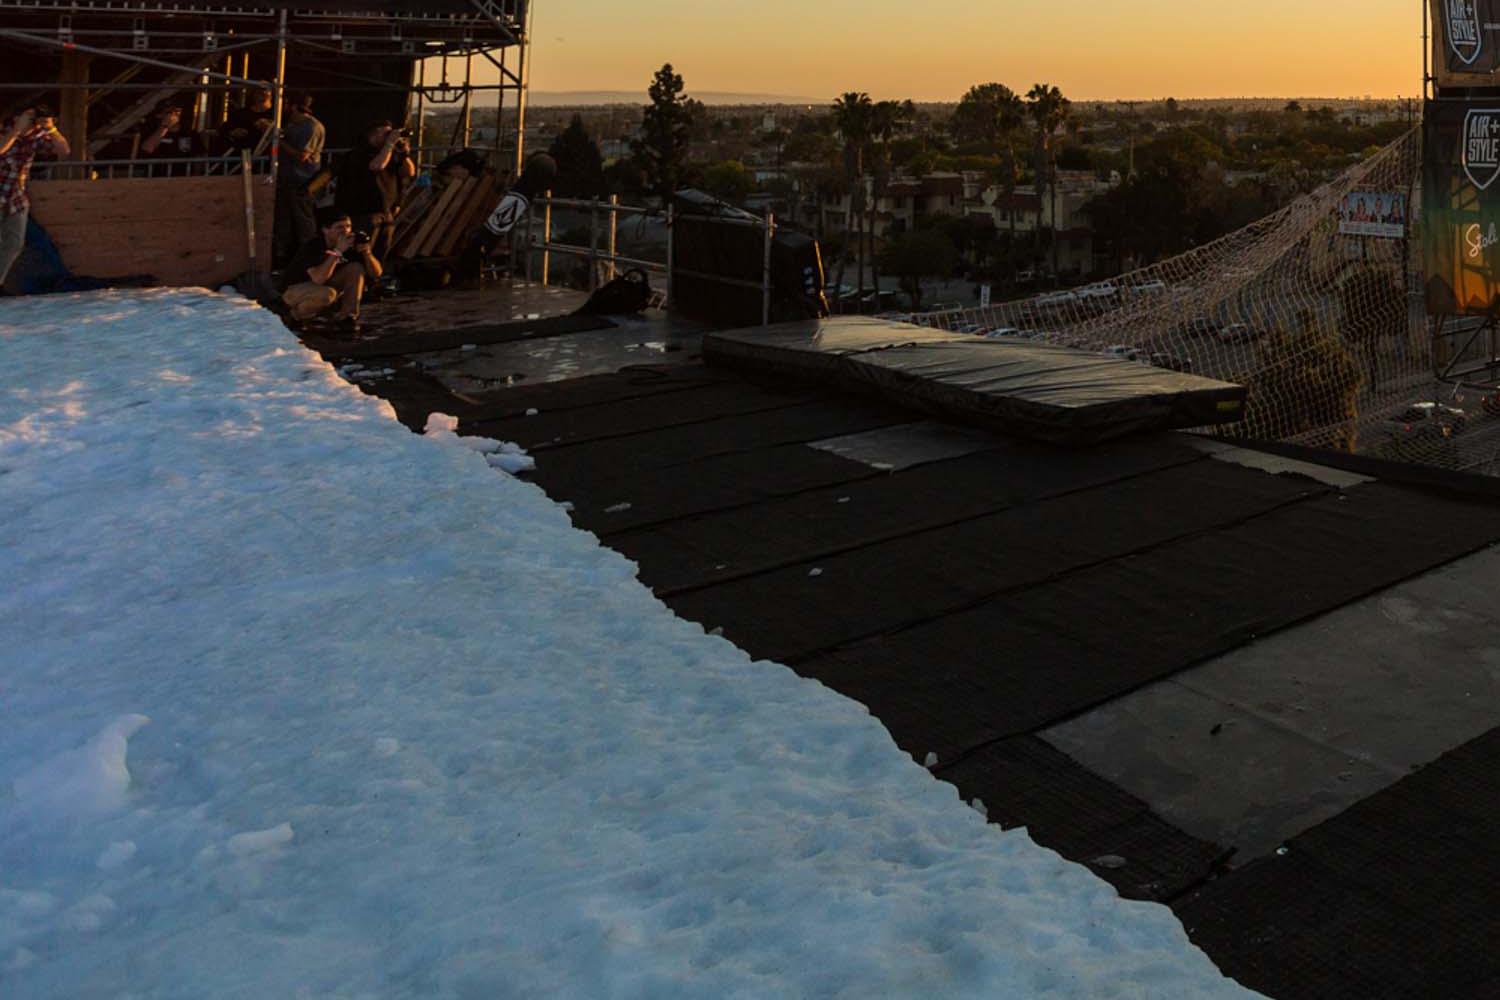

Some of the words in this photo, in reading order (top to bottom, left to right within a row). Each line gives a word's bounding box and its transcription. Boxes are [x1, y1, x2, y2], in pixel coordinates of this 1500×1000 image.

[1451, 19, 1477, 40] STYLE
[1469, 115, 1500, 138] AIR+
[1468, 138, 1500, 162] STYLE
[1465, 221, 1499, 258] Stoli
